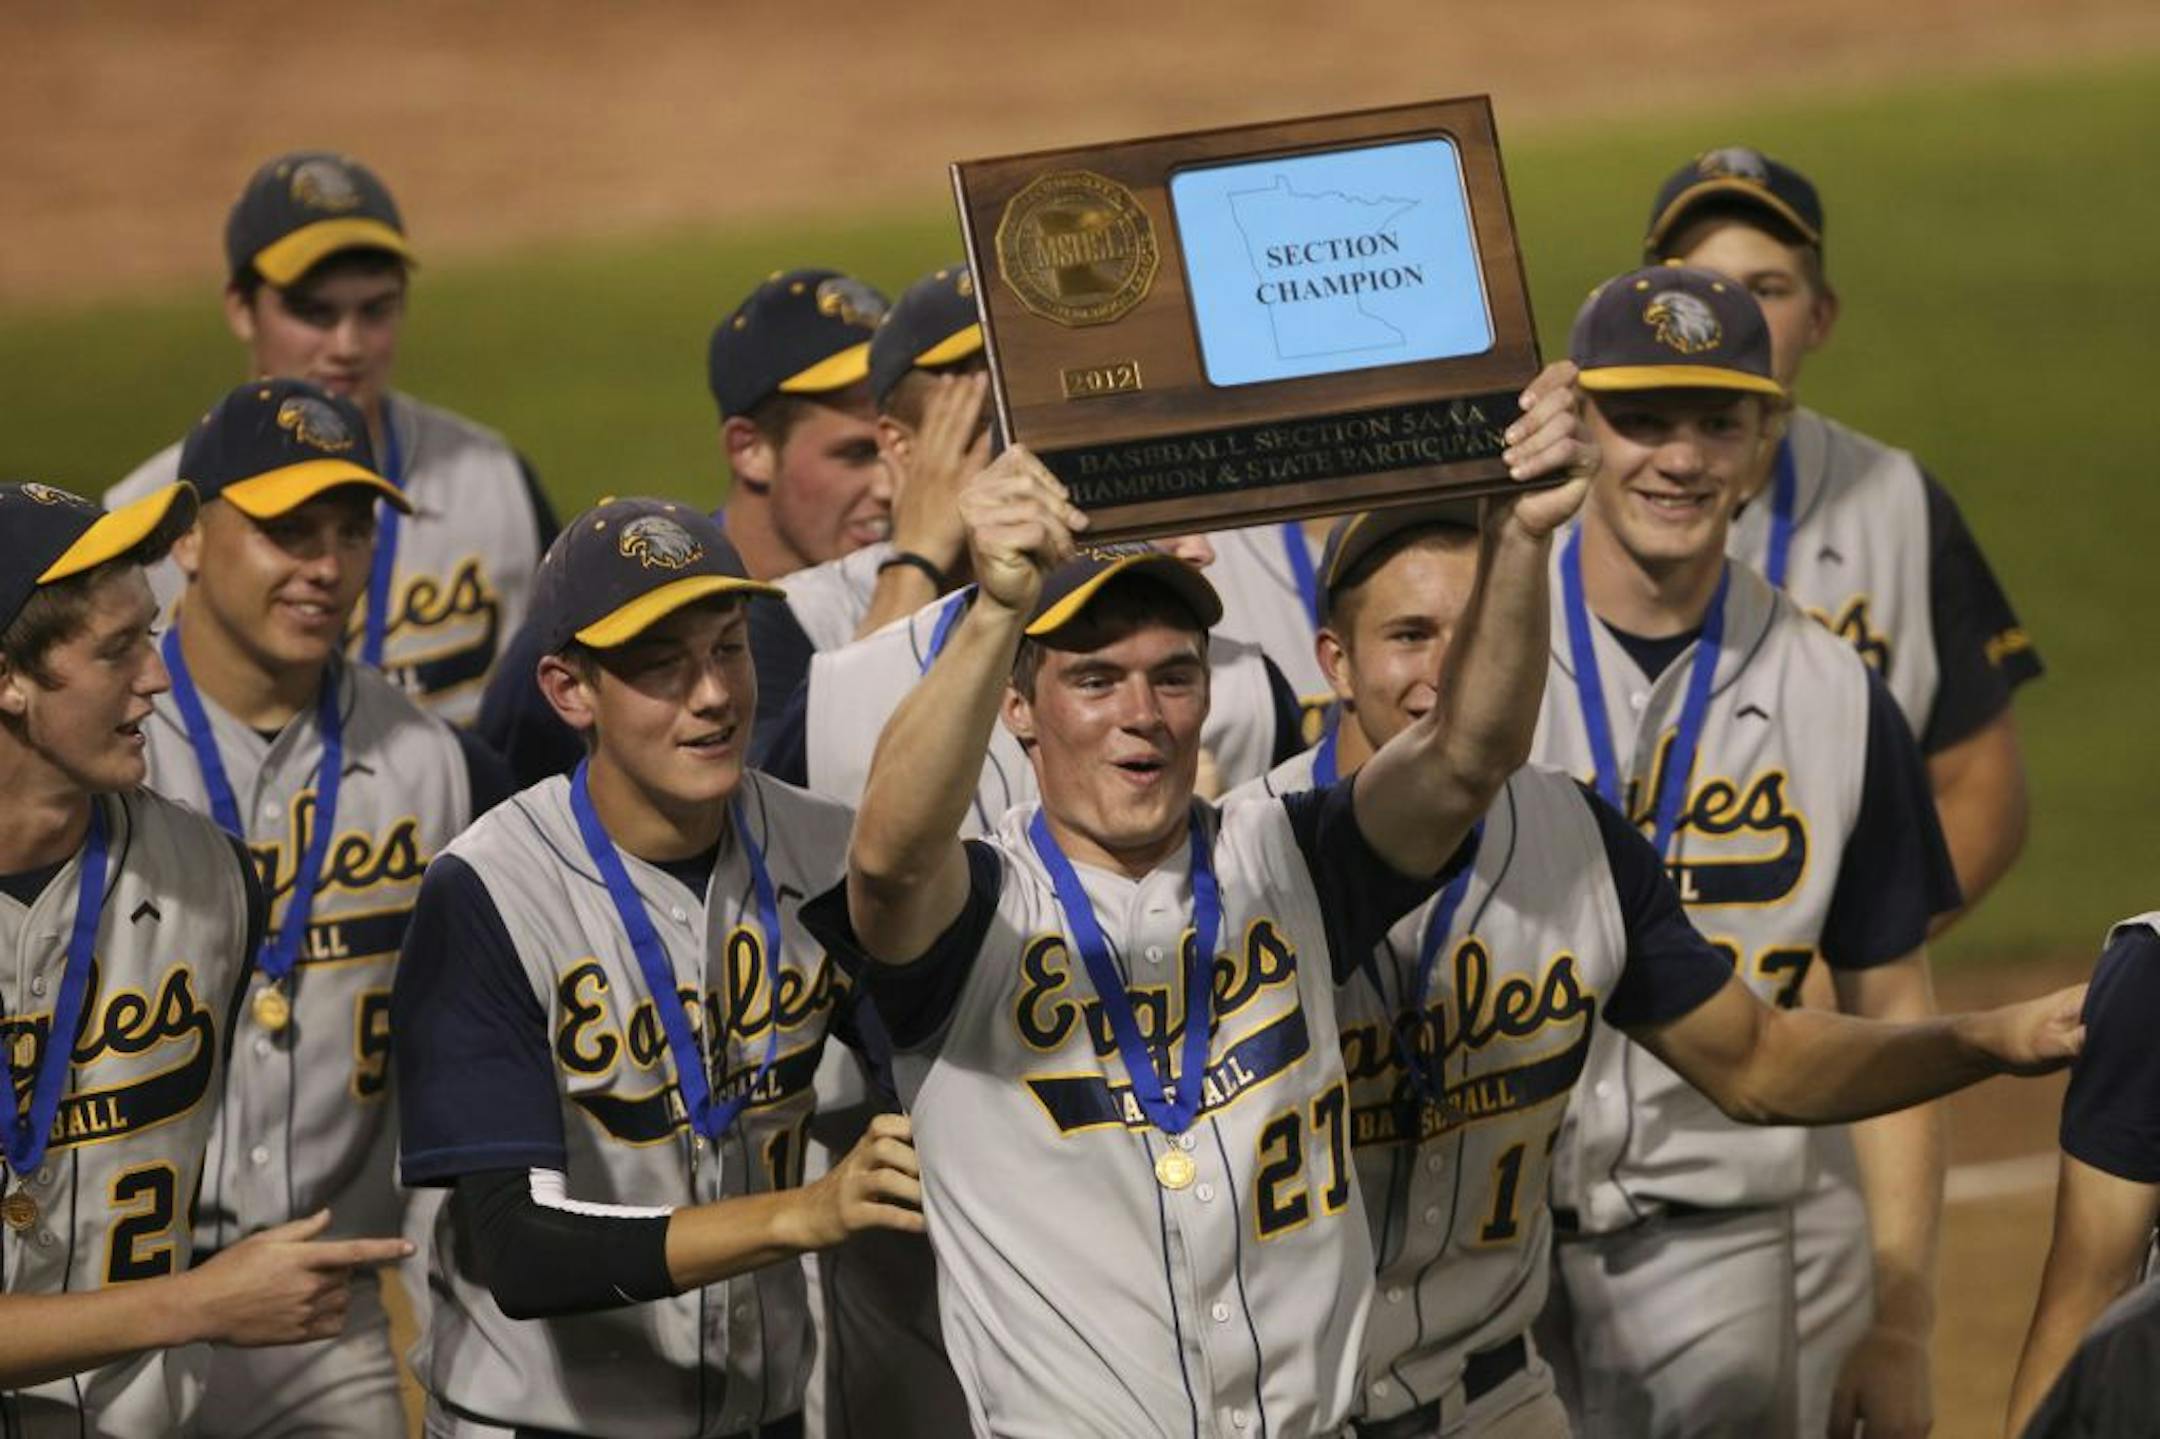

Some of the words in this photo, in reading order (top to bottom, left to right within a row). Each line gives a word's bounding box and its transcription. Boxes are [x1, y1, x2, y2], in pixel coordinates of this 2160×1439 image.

[1266, 229, 1400, 269] SECTION
[1255, 263, 1424, 305] CHAMPION
[1067, 364, 1136, 394] 2012
[1070, 466, 1209, 502] HAMPION
[1217, 461, 1239, 484] &
[1247, 451, 1330, 482] STATE
[1343, 426, 1507, 466] PARTICIPAN
[1080, 434, 1247, 474] BASEBALL
[1253, 415, 1391, 450] SECTION
[1252, 1078, 1350, 1242] 27
[104, 1158, 178, 1288] 2
